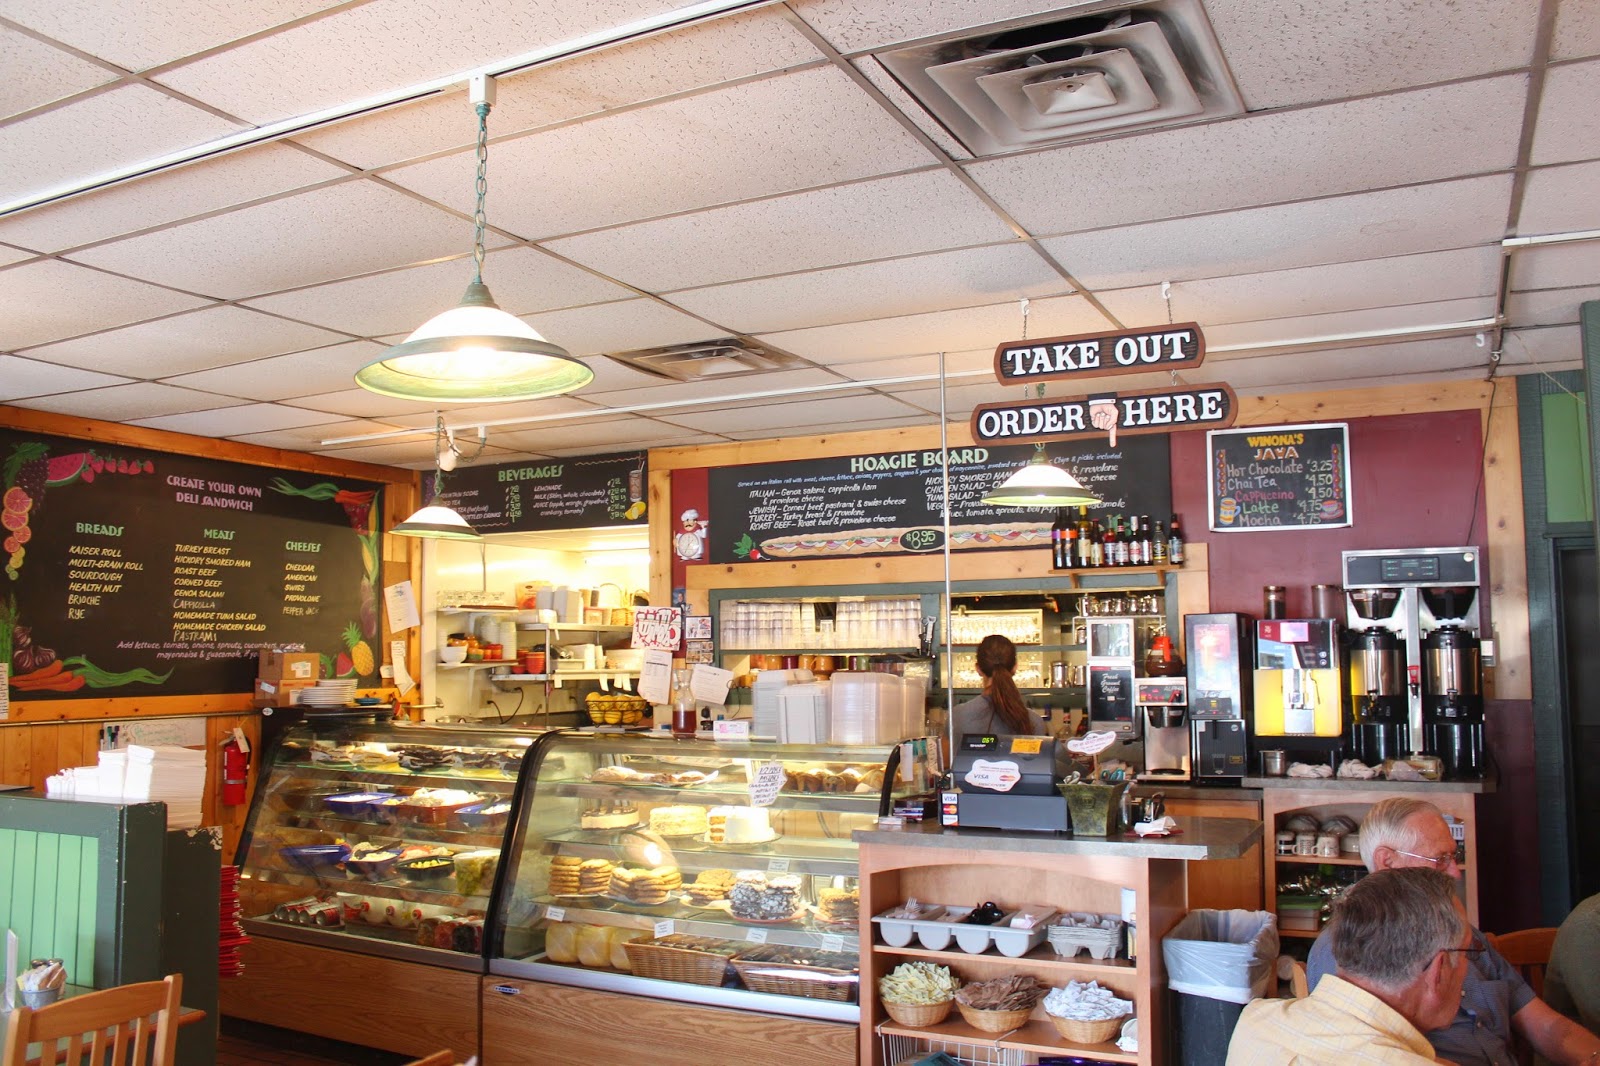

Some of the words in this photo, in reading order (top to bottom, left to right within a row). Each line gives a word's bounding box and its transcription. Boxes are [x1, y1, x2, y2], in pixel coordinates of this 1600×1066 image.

[1006, 341, 1100, 376] TAKE
[1114, 332, 1191, 366] OUT
[979, 404, 1085, 437] ORDER
[1122, 391, 1223, 427] HERE
[1246, 433, 1304, 448] WINONA'S
[1253, 446, 1299, 460] JAVA
[850, 453, 917, 473] HOAGIE
[922, 448, 989, 467] BOARD
[1248, 459, 1303, 475] Chocolate
[498, 464, 563, 482] BEVERAGES
[959, 472, 992, 482] SMOKED
[1090, 473, 1117, 482] cheese
[166, 475, 205, 490] CREATE
[207, 481, 235, 494] YOUR
[238, 485, 262, 498] OWN
[959, 482, 985, 491] SALAD
[1227, 477, 1253, 491] Chai
[1254, 475, 1277, 488] Tea
[749, 489, 775, 498] ITALIAN
[949, 491, 974, 500] SALAD
[1235, 490, 1295, 502] Cappuccino
[176, 491, 199, 504] DELI
[200, 495, 254, 511] SANDWICH
[748, 505, 777, 515] JEWISH
[1242, 500, 1279, 515] Latte
[748, 513, 777, 523] TURKEY
[1239, 514, 1281, 526] Mocha
[76, 522, 124, 537] BREADS
[749, 522, 773, 531] ROAST
[773, 521, 792, 529] BEEF
[203, 528, 236, 540] MEATS
[68, 545, 100, 556] KAISER
[101, 548, 122, 558] ROLL
[175, 543, 203, 554] TURKEY
[203, 546, 231, 555] BREAST
[285, 540, 322, 553] CHEESES
[68, 559, 124, 569] MULTI-GRAIN
[124, 561, 144, 571] ROLL
[174, 555, 205, 565] HICKORY
[205, 557, 235, 567] SMOKED
[235, 560, 251, 568] HAM
[174, 566, 198, 575] ROAST
[198, 568, 218, 576] BEEF
[285, 563, 315, 572] CHEDDAR
[68, 570, 123, 581] SOURDOUGH
[284, 573, 318, 582] AMERICAN
[68, 582, 102, 592] HEALTH
[102, 584, 122, 593] NUT
[173, 578, 203, 587] CORNED
[203, 579, 223, 588] BEEF
[284, 584, 305, 592] SWISS
[173, 589, 198, 597] GENOA
[198, 590, 225, 599] SALAMI
[284, 594, 321, 603] PROVOLONE
[173, 611, 216, 620] HOMEMADE
[216, 612, 235, 620] TUNA
[235, 612, 257, 621] SALAD
[172, 622, 215, 631] HOMEMADE
[215, 623, 244, 632] CHICKEN
[244, 623, 266, 632] SALAD
[117, 640, 134, 649] Add
